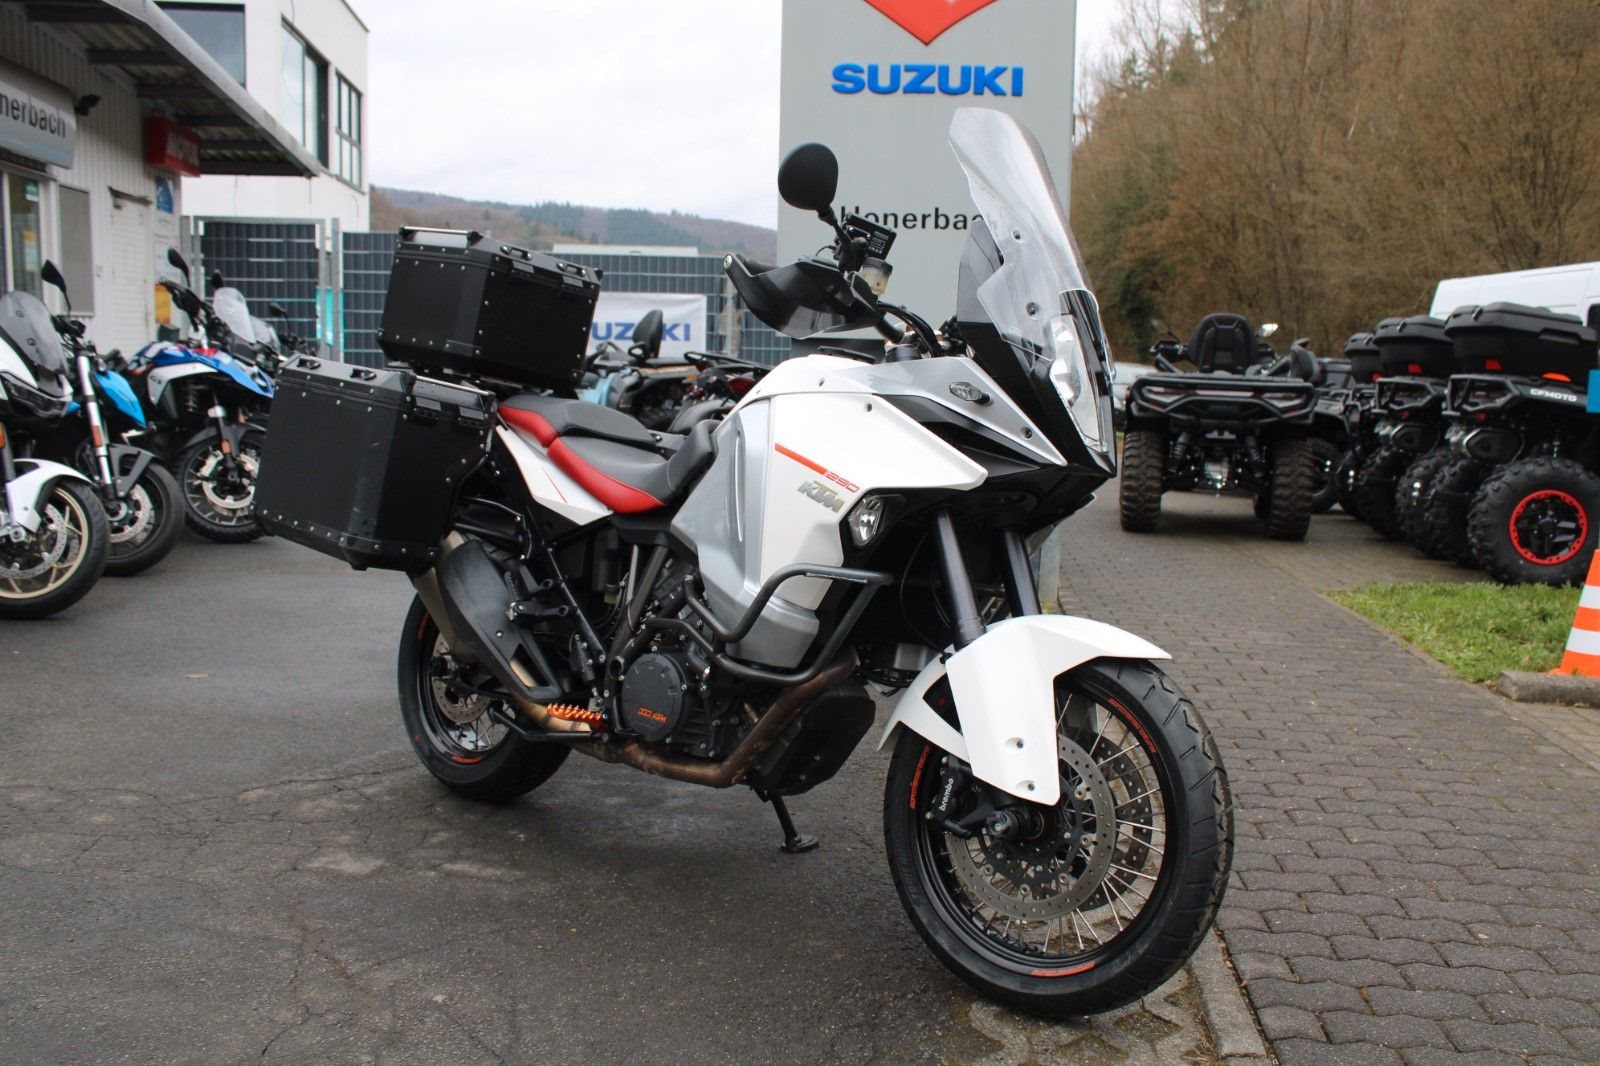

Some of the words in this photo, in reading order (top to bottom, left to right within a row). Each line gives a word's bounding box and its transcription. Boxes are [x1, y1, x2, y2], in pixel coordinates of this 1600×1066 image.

[831, 63, 1024, 97] SUZUKI
[591, 322, 691, 342] UZKI
[797, 480, 845, 513] KTM
[938, 778, 954, 811] brembo
